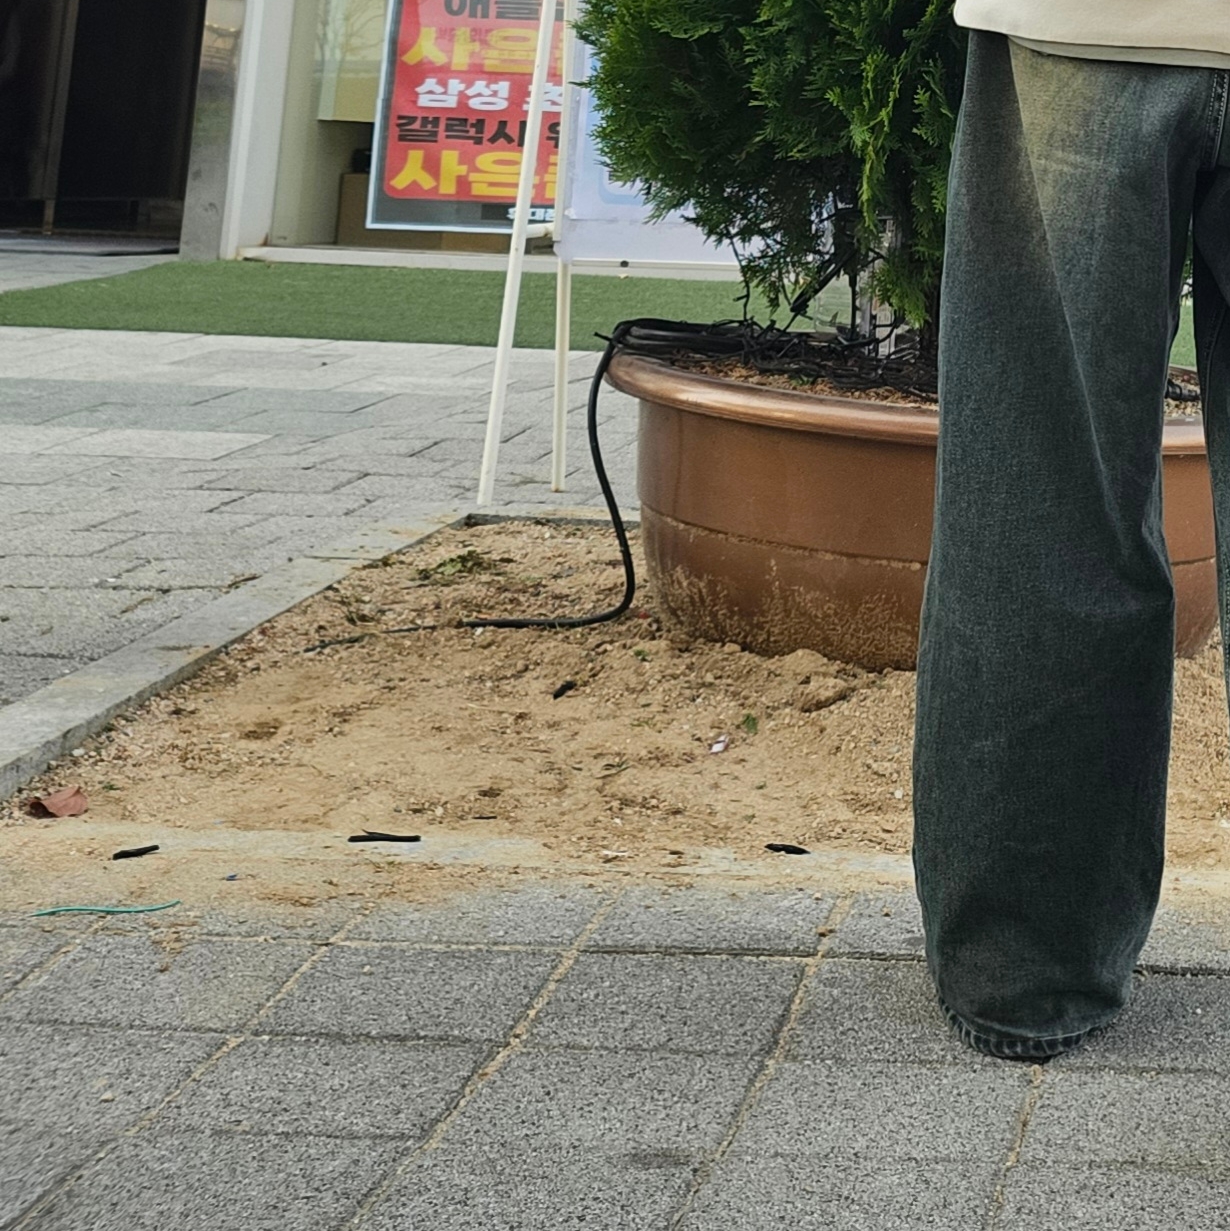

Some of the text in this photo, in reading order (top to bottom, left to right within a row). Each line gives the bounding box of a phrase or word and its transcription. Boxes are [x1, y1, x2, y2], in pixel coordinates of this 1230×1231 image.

[401, 26, 563, 75] 사은
[414, 78, 511, 111] 삼성
[395, 114, 527, 148] 갤럭시
[389, 149, 559, 200] 사은
